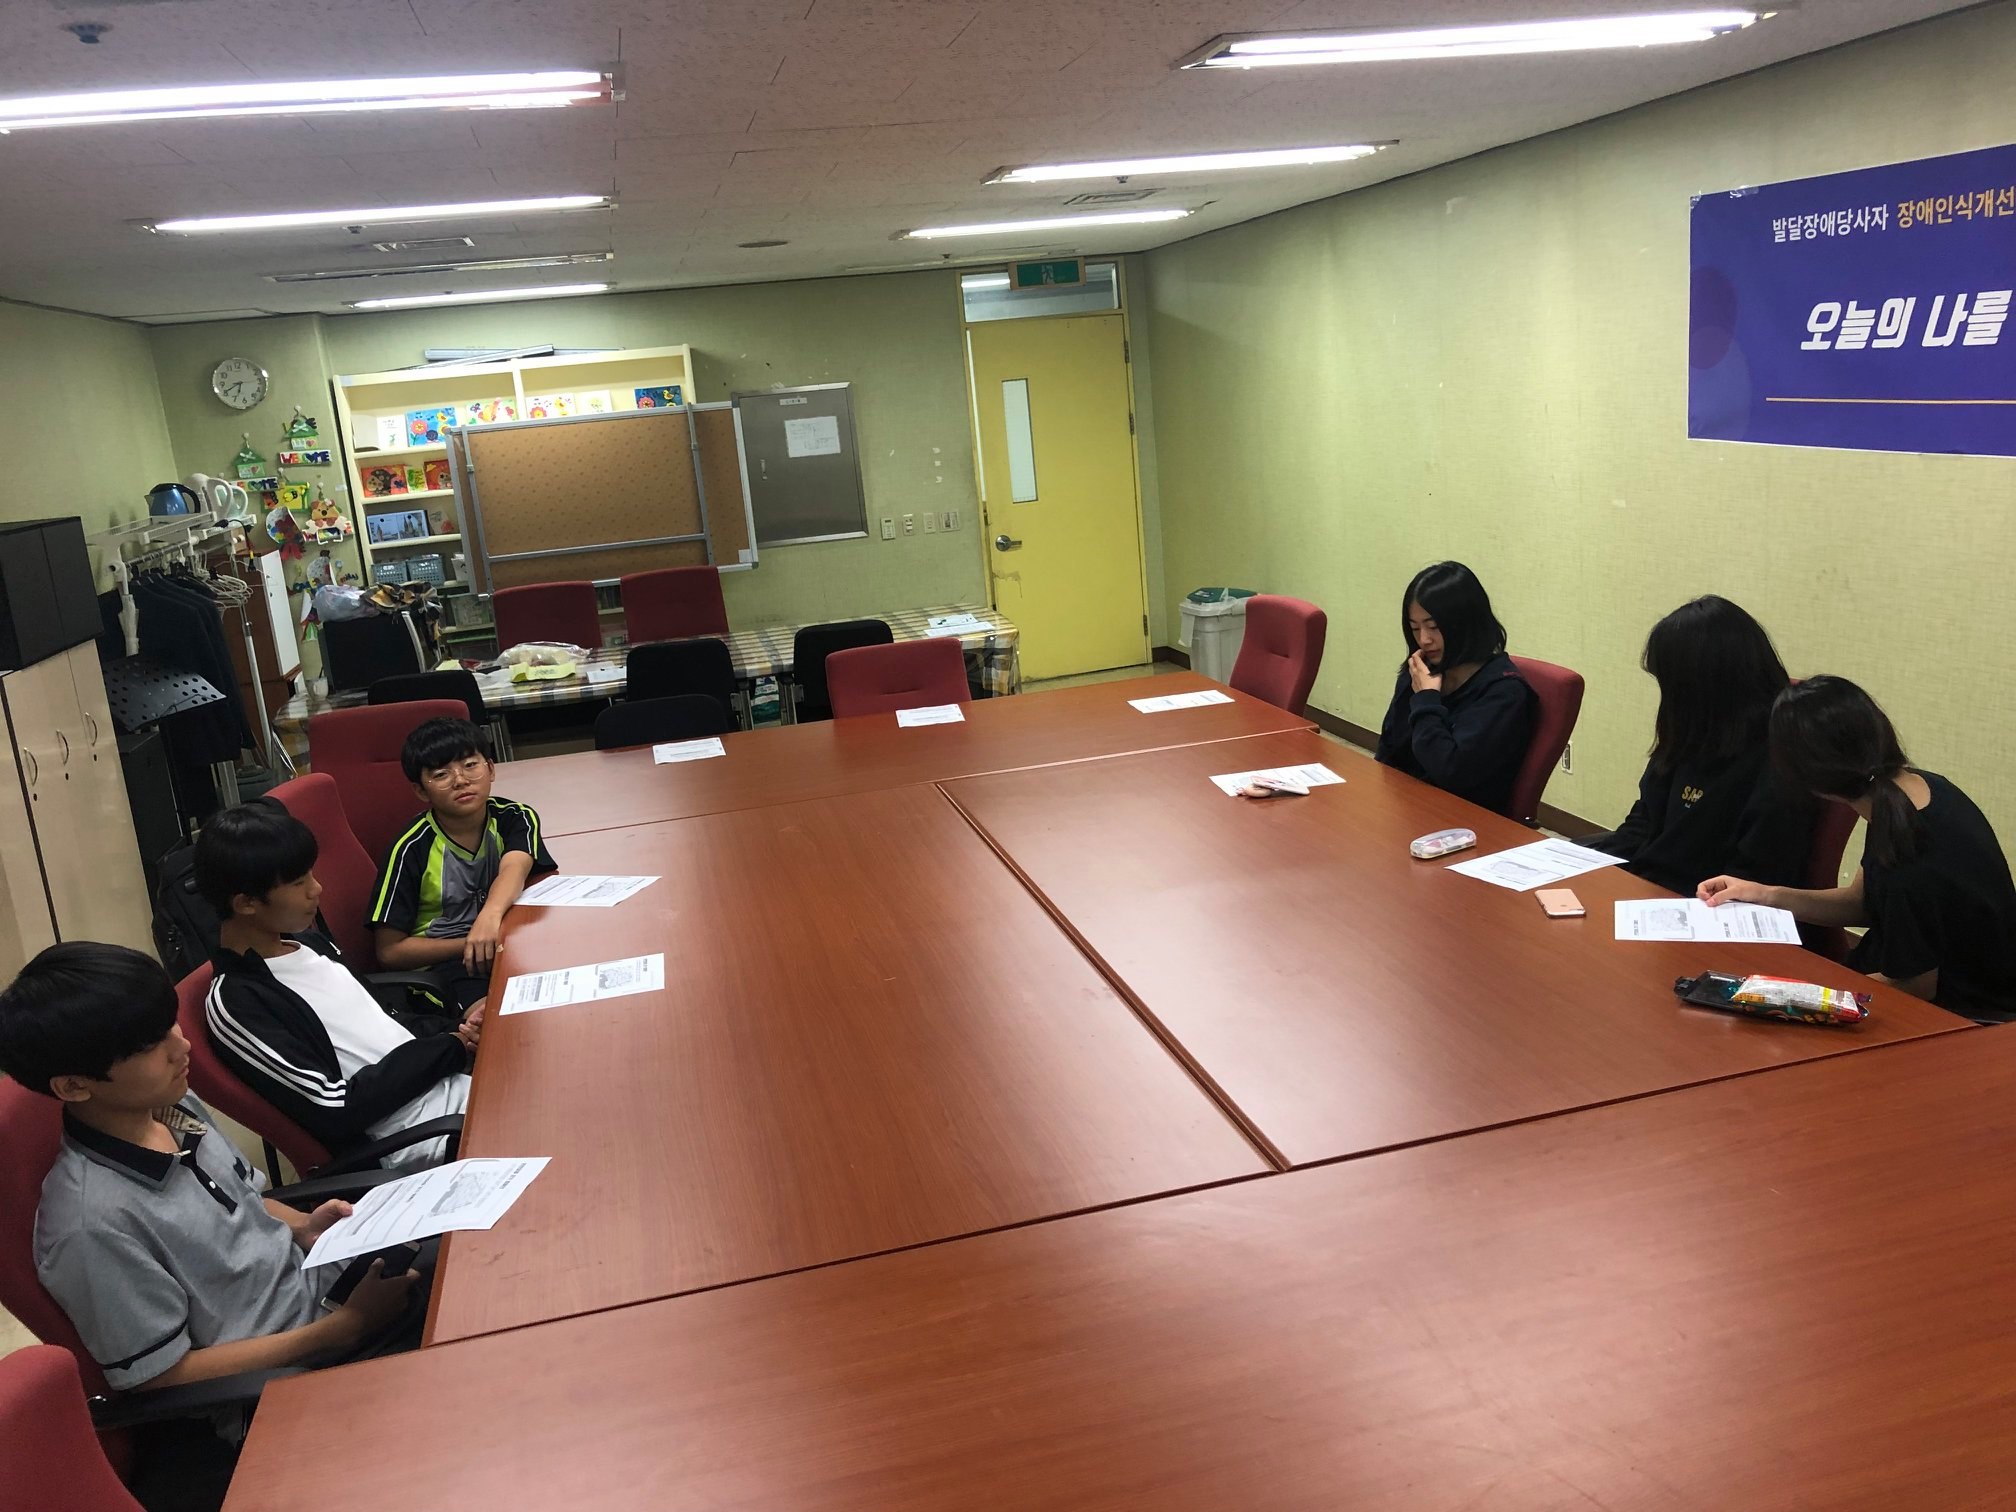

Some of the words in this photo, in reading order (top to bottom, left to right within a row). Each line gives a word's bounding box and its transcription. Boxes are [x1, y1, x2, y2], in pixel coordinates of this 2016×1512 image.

[1773, 204, 1889, 243] 발달장애당사자
[1897, 186, 2015, 228] 장애인식개선
[1801, 297, 1917, 351] 오늘의
[1922, 290, 2013, 347] 나를
